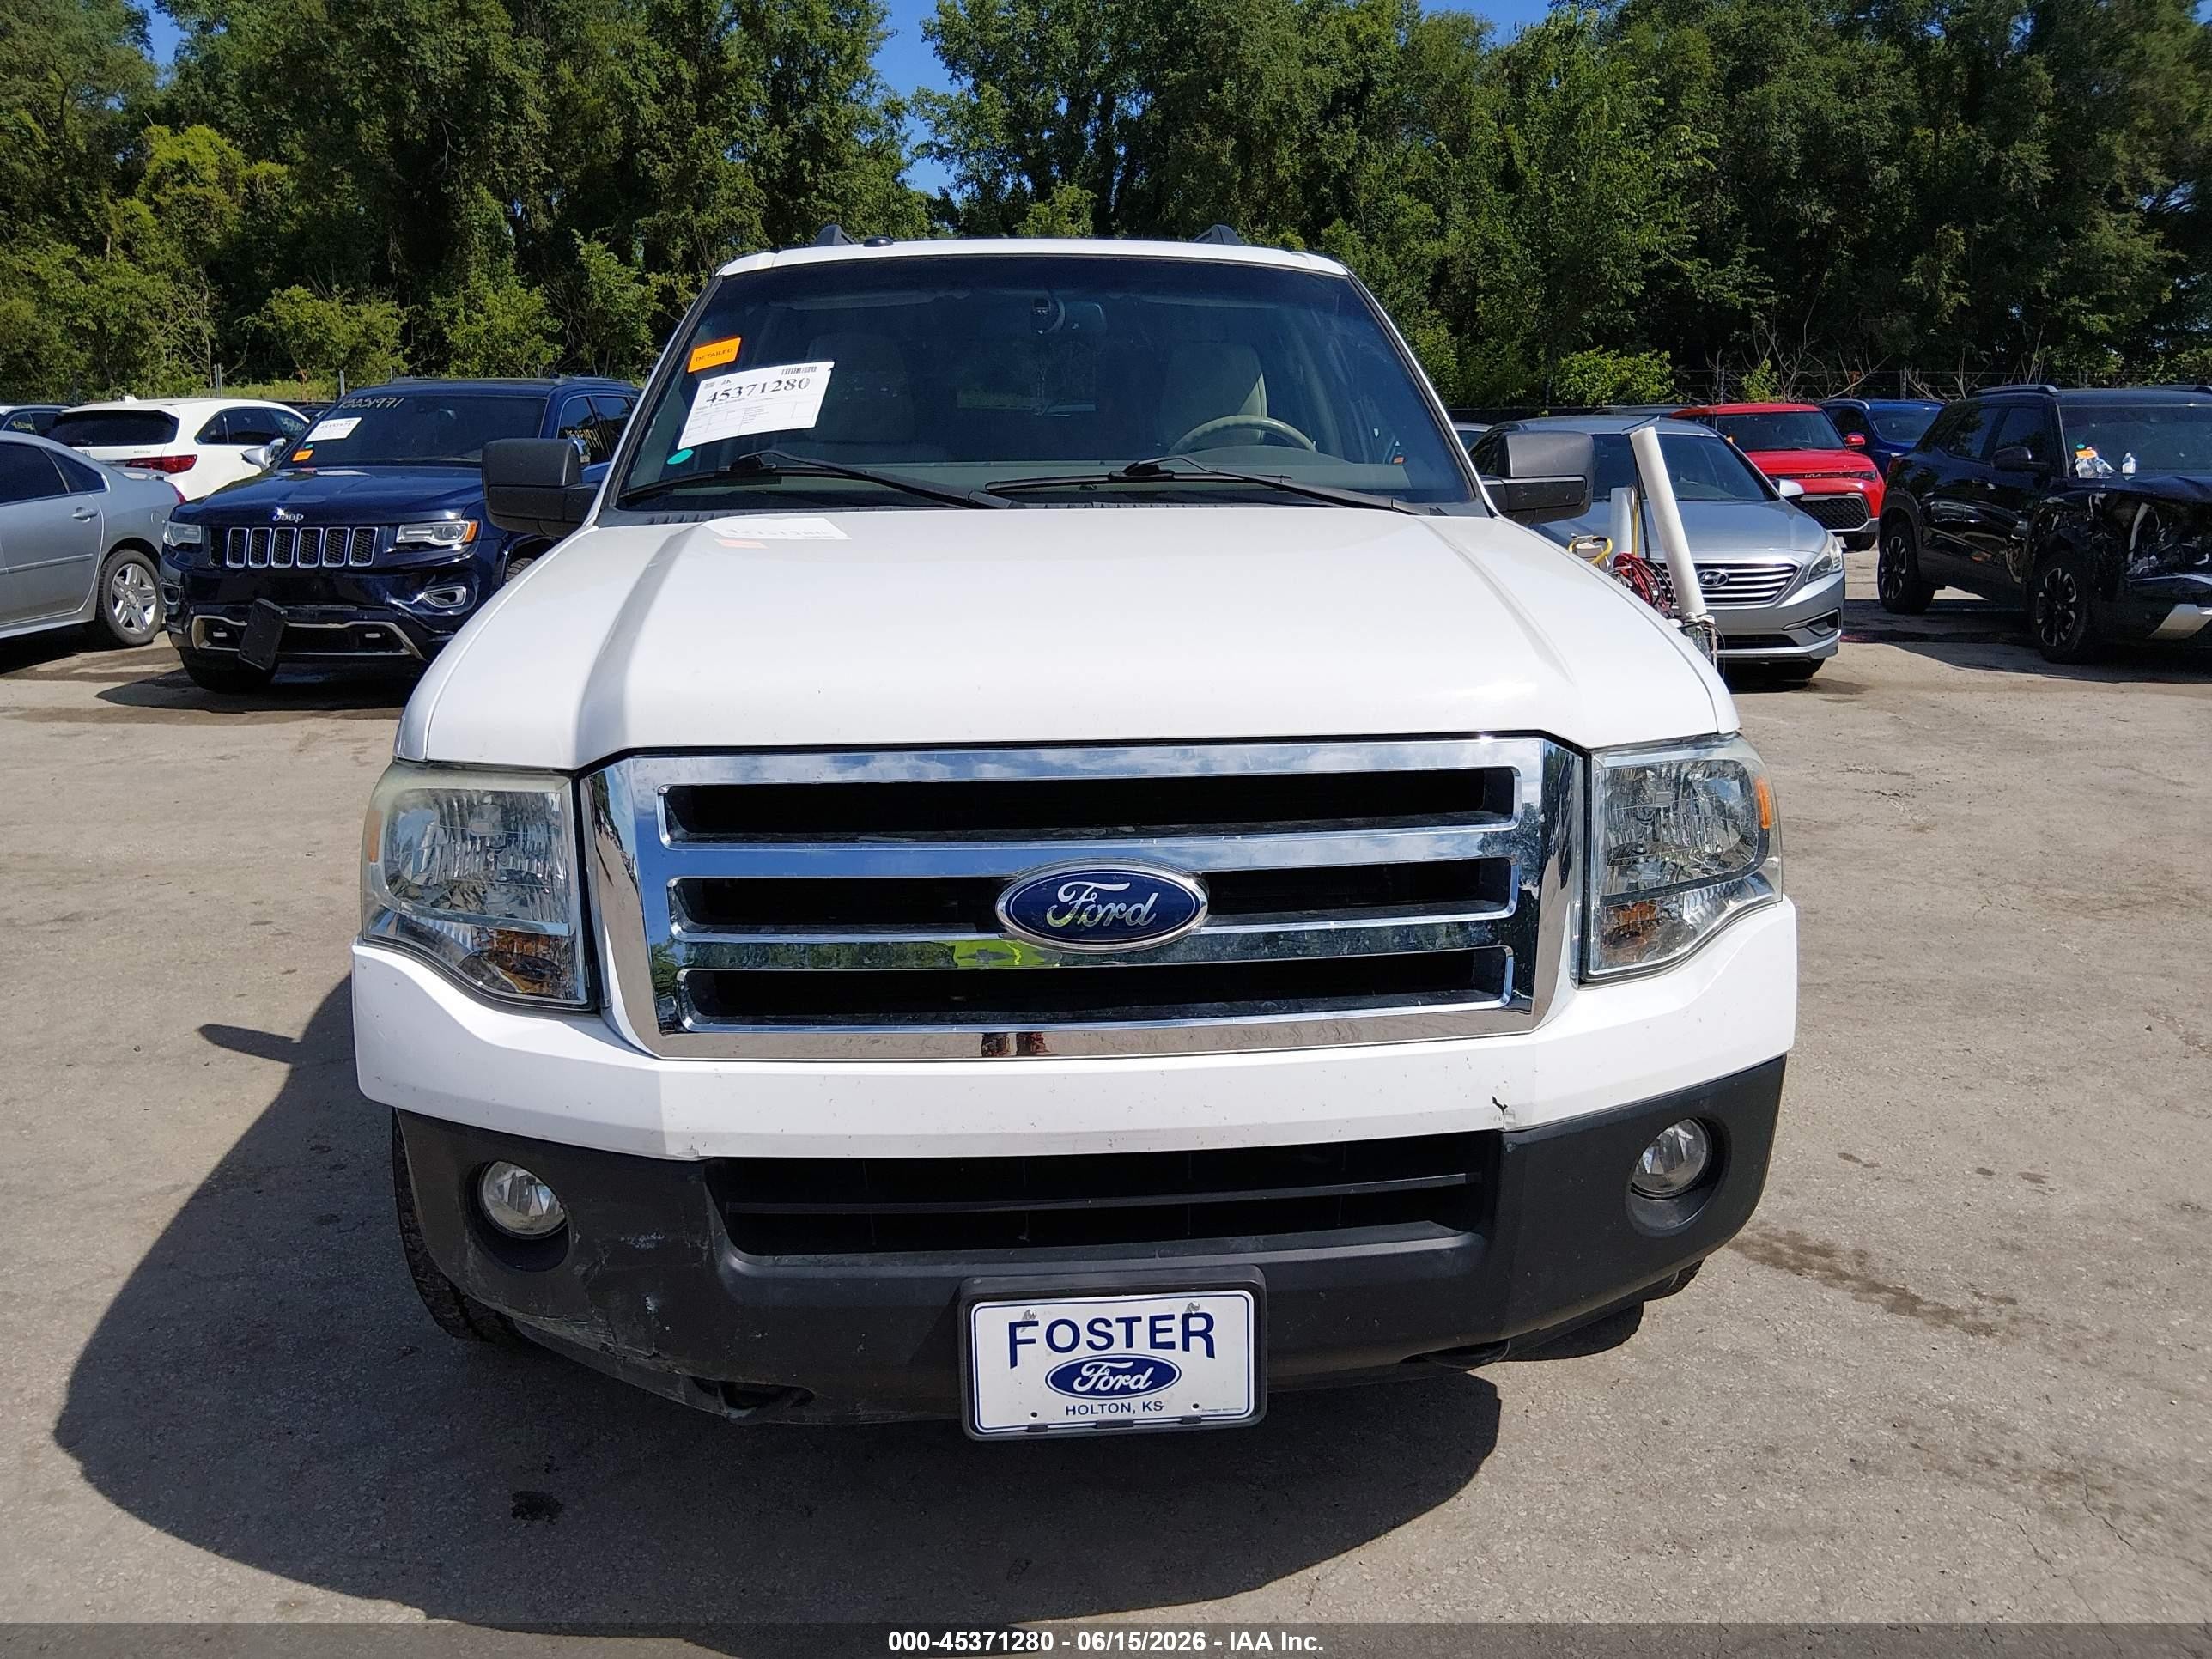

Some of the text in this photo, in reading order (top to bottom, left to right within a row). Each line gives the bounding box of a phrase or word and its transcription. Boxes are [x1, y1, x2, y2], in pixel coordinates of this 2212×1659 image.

[706, 376, 811, 404] 45371280
[1046, 881, 1159, 927] Ford
[1007, 1311, 1216, 1370] FOSTER
[1073, 1360, 1154, 1393] Ford
[1066, 1401, 1164, 1417] HOLTON, KS
